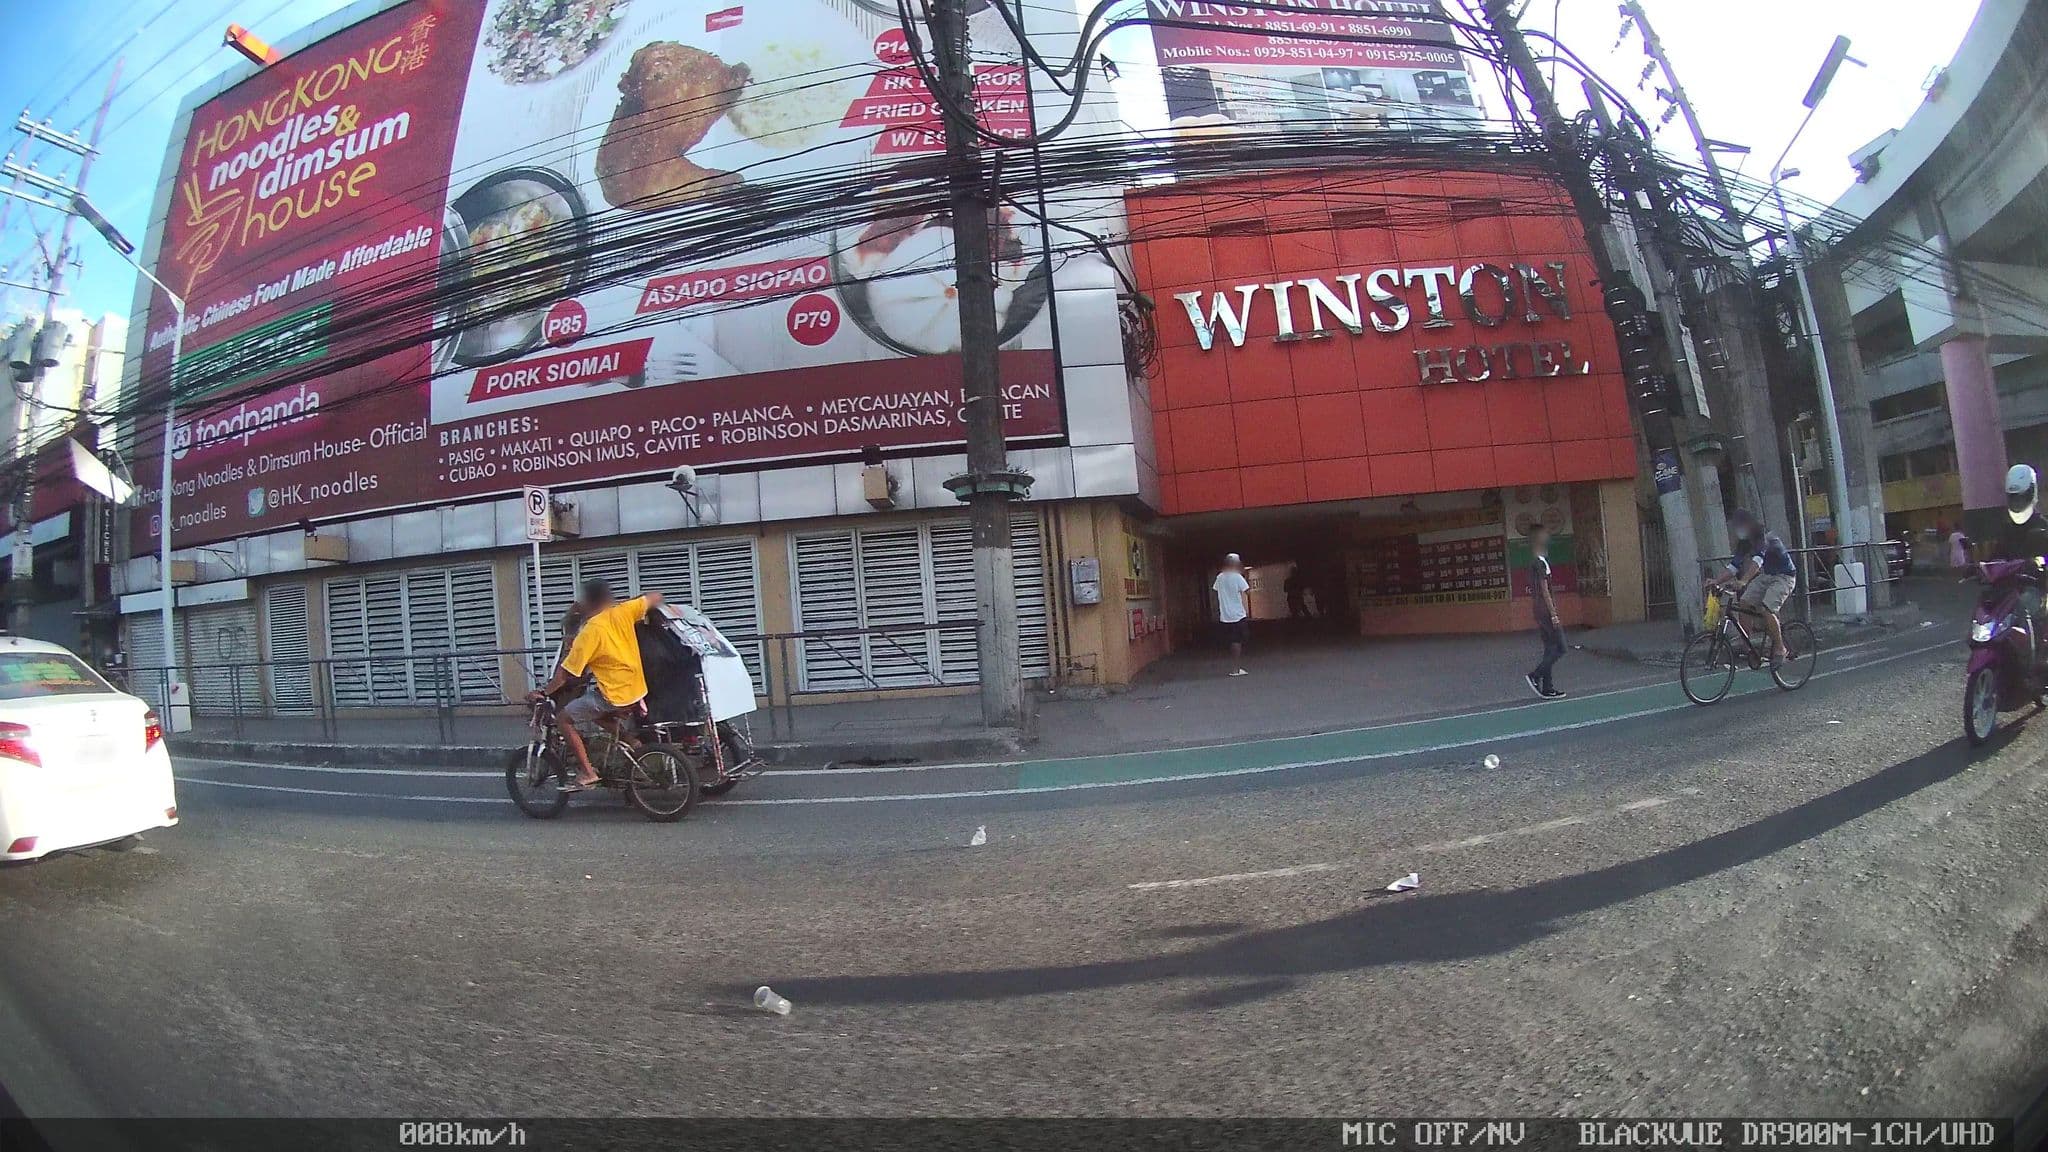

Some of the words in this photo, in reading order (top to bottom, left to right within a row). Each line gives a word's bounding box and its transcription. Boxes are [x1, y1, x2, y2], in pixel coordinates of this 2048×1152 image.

[401, 14, 437, 74] 香港
[1348, 23, 1412, 37] 8851-6990
[1163, 46, 1212, 58] Mobile
[1254, 47, 1353, 60] 0929-851-04-97
[1366, 49, 1456, 63] 0915-925-0005
[192, 36, 402, 167] HONGKONG
[884, 77, 913, 90] HK
[863, 103, 926, 119] FRIED
[930, 100, 1025, 115] CKEN
[259, 112, 410, 200] dimsum
[891, 132, 918, 146] W/
[241, 161, 376, 246] house
[202, 295, 252, 328] Chinese
[253, 275, 290, 306] Food
[292, 260, 336, 292] Made
[338, 225, 434, 275] Affordable
[644, 277, 726, 308] ASADO
[733, 265, 827, 293] SIOPAO
[548, 315, 582, 338] P85
[793, 309, 832, 330] P79
[1174, 261, 1571, 351] WINSTON
[486, 368, 540, 393] PORK
[546, 352, 620, 382] SIOMAI
[1413, 341, 1591, 386] HOTEL
[197, 385, 320, 450] foodpanda
[440, 417, 540, 447] BRANCHES:
[449, 448, 485, 466] PASIG
[500, 437, 552, 458] MAKATI
[570, 425, 632, 448] QUIAPO
[651, 416, 697, 435] PACO
[713, 405, 793, 427] PALANCA
[821, 390, 954, 416] MEYCAUAYAN,
[198, 463, 243, 490] Noodles
[247, 458, 257, 477] &
[259, 445, 311, 475] Dimsum
[370, 419, 428, 449] Official
[450, 463, 496, 483] CUBAO
[512, 450, 592, 473] ROBINSON
[596, 443, 640, 462] IMUS,
[644, 434, 701, 455] CAVITE
[722, 421, 818, 445] ROBINSON
[268, 471, 379, 508] @HK_noodles
